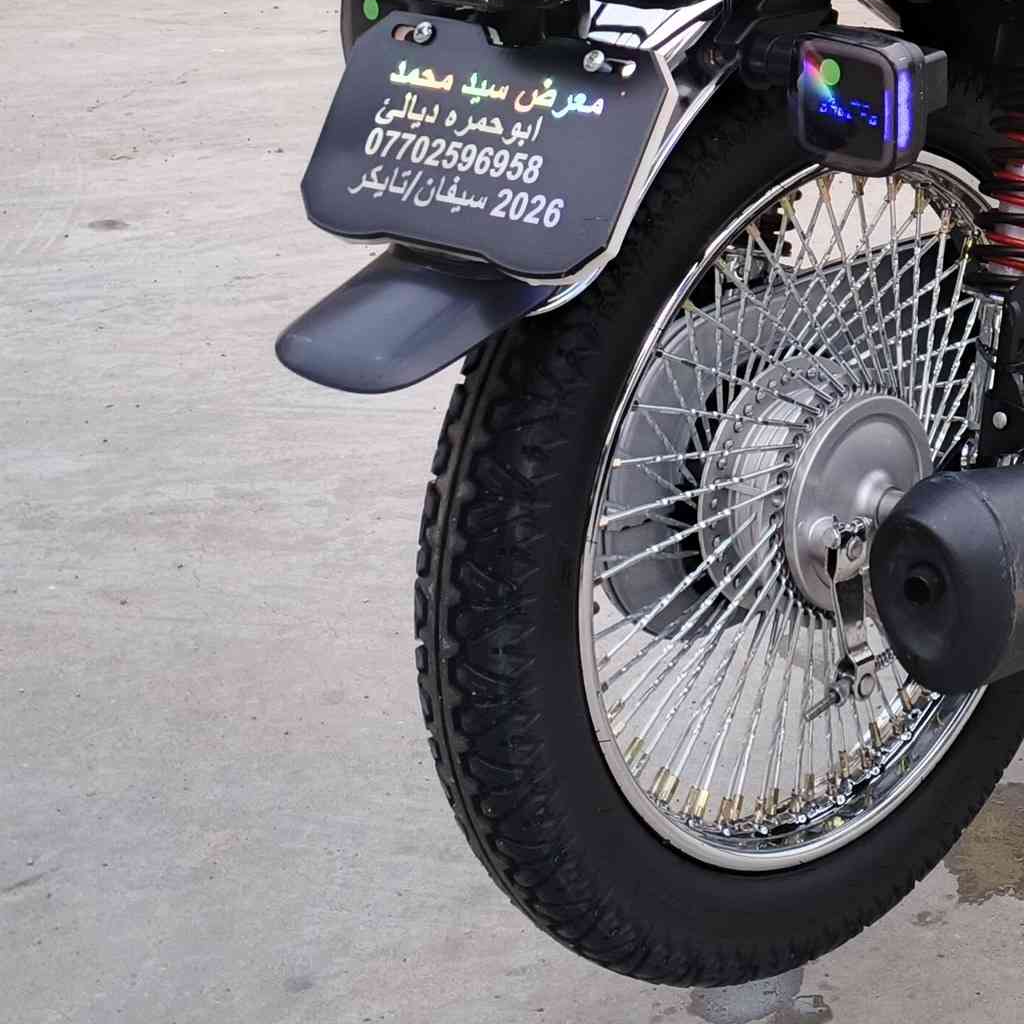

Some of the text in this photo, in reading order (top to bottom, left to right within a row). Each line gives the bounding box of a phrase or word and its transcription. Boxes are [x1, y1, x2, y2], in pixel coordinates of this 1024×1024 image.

[390, 60, 604, 119] معرض سيد محمد
[364, 127, 544, 184] 07702596958
[490, 188, 565, 228] 2026
